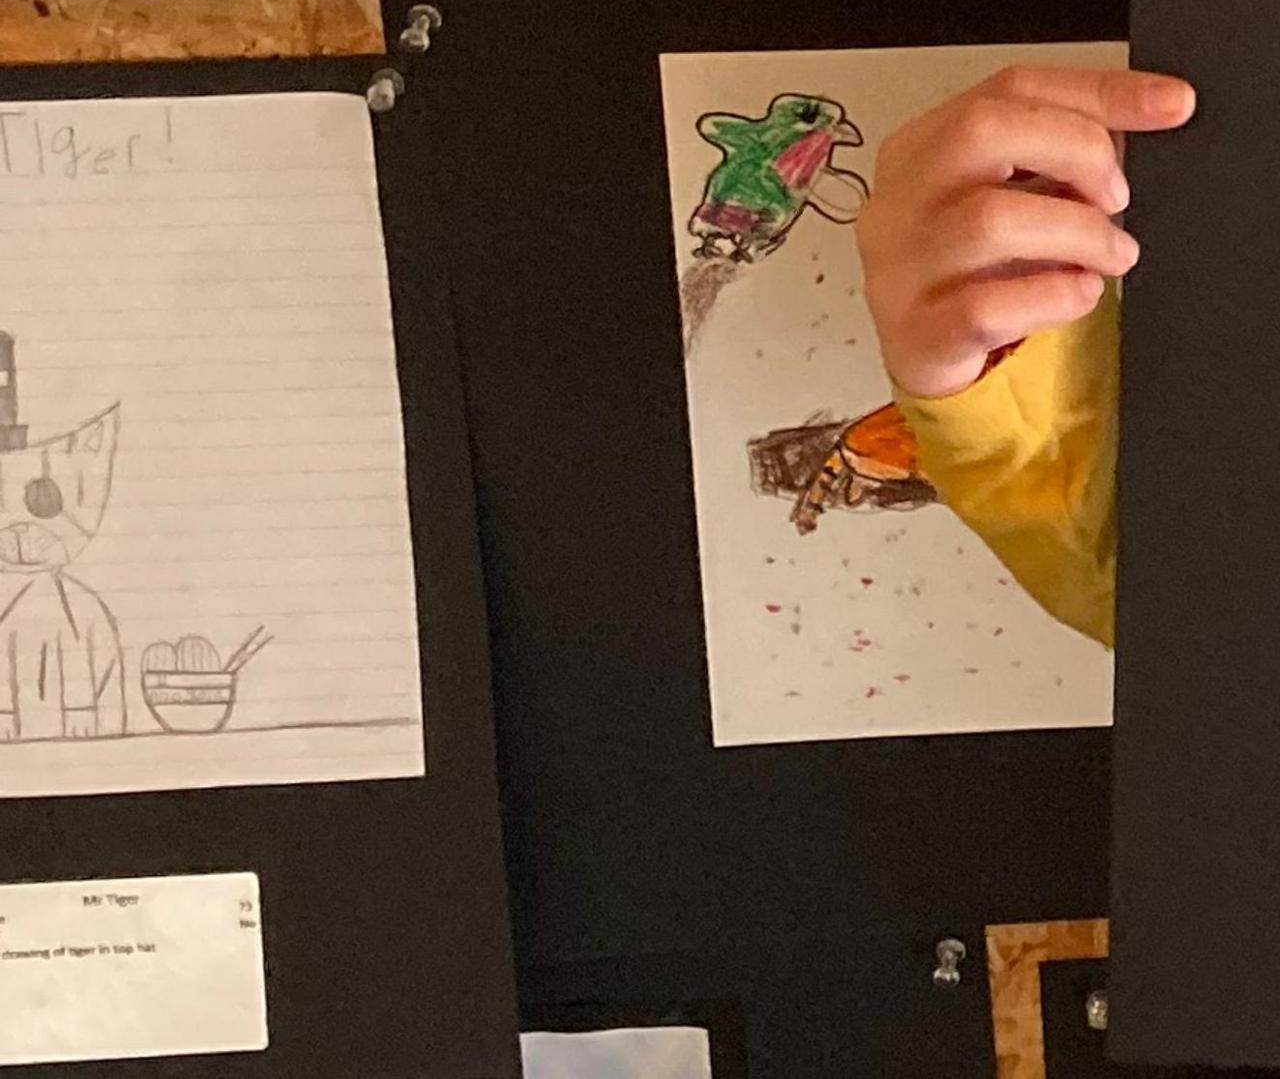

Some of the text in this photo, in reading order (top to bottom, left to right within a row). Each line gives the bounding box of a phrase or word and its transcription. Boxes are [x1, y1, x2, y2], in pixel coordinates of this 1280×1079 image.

[106, 893, 140, 908] Tiger
[2, 941, 156, 960] drawing of tiger in top hat
